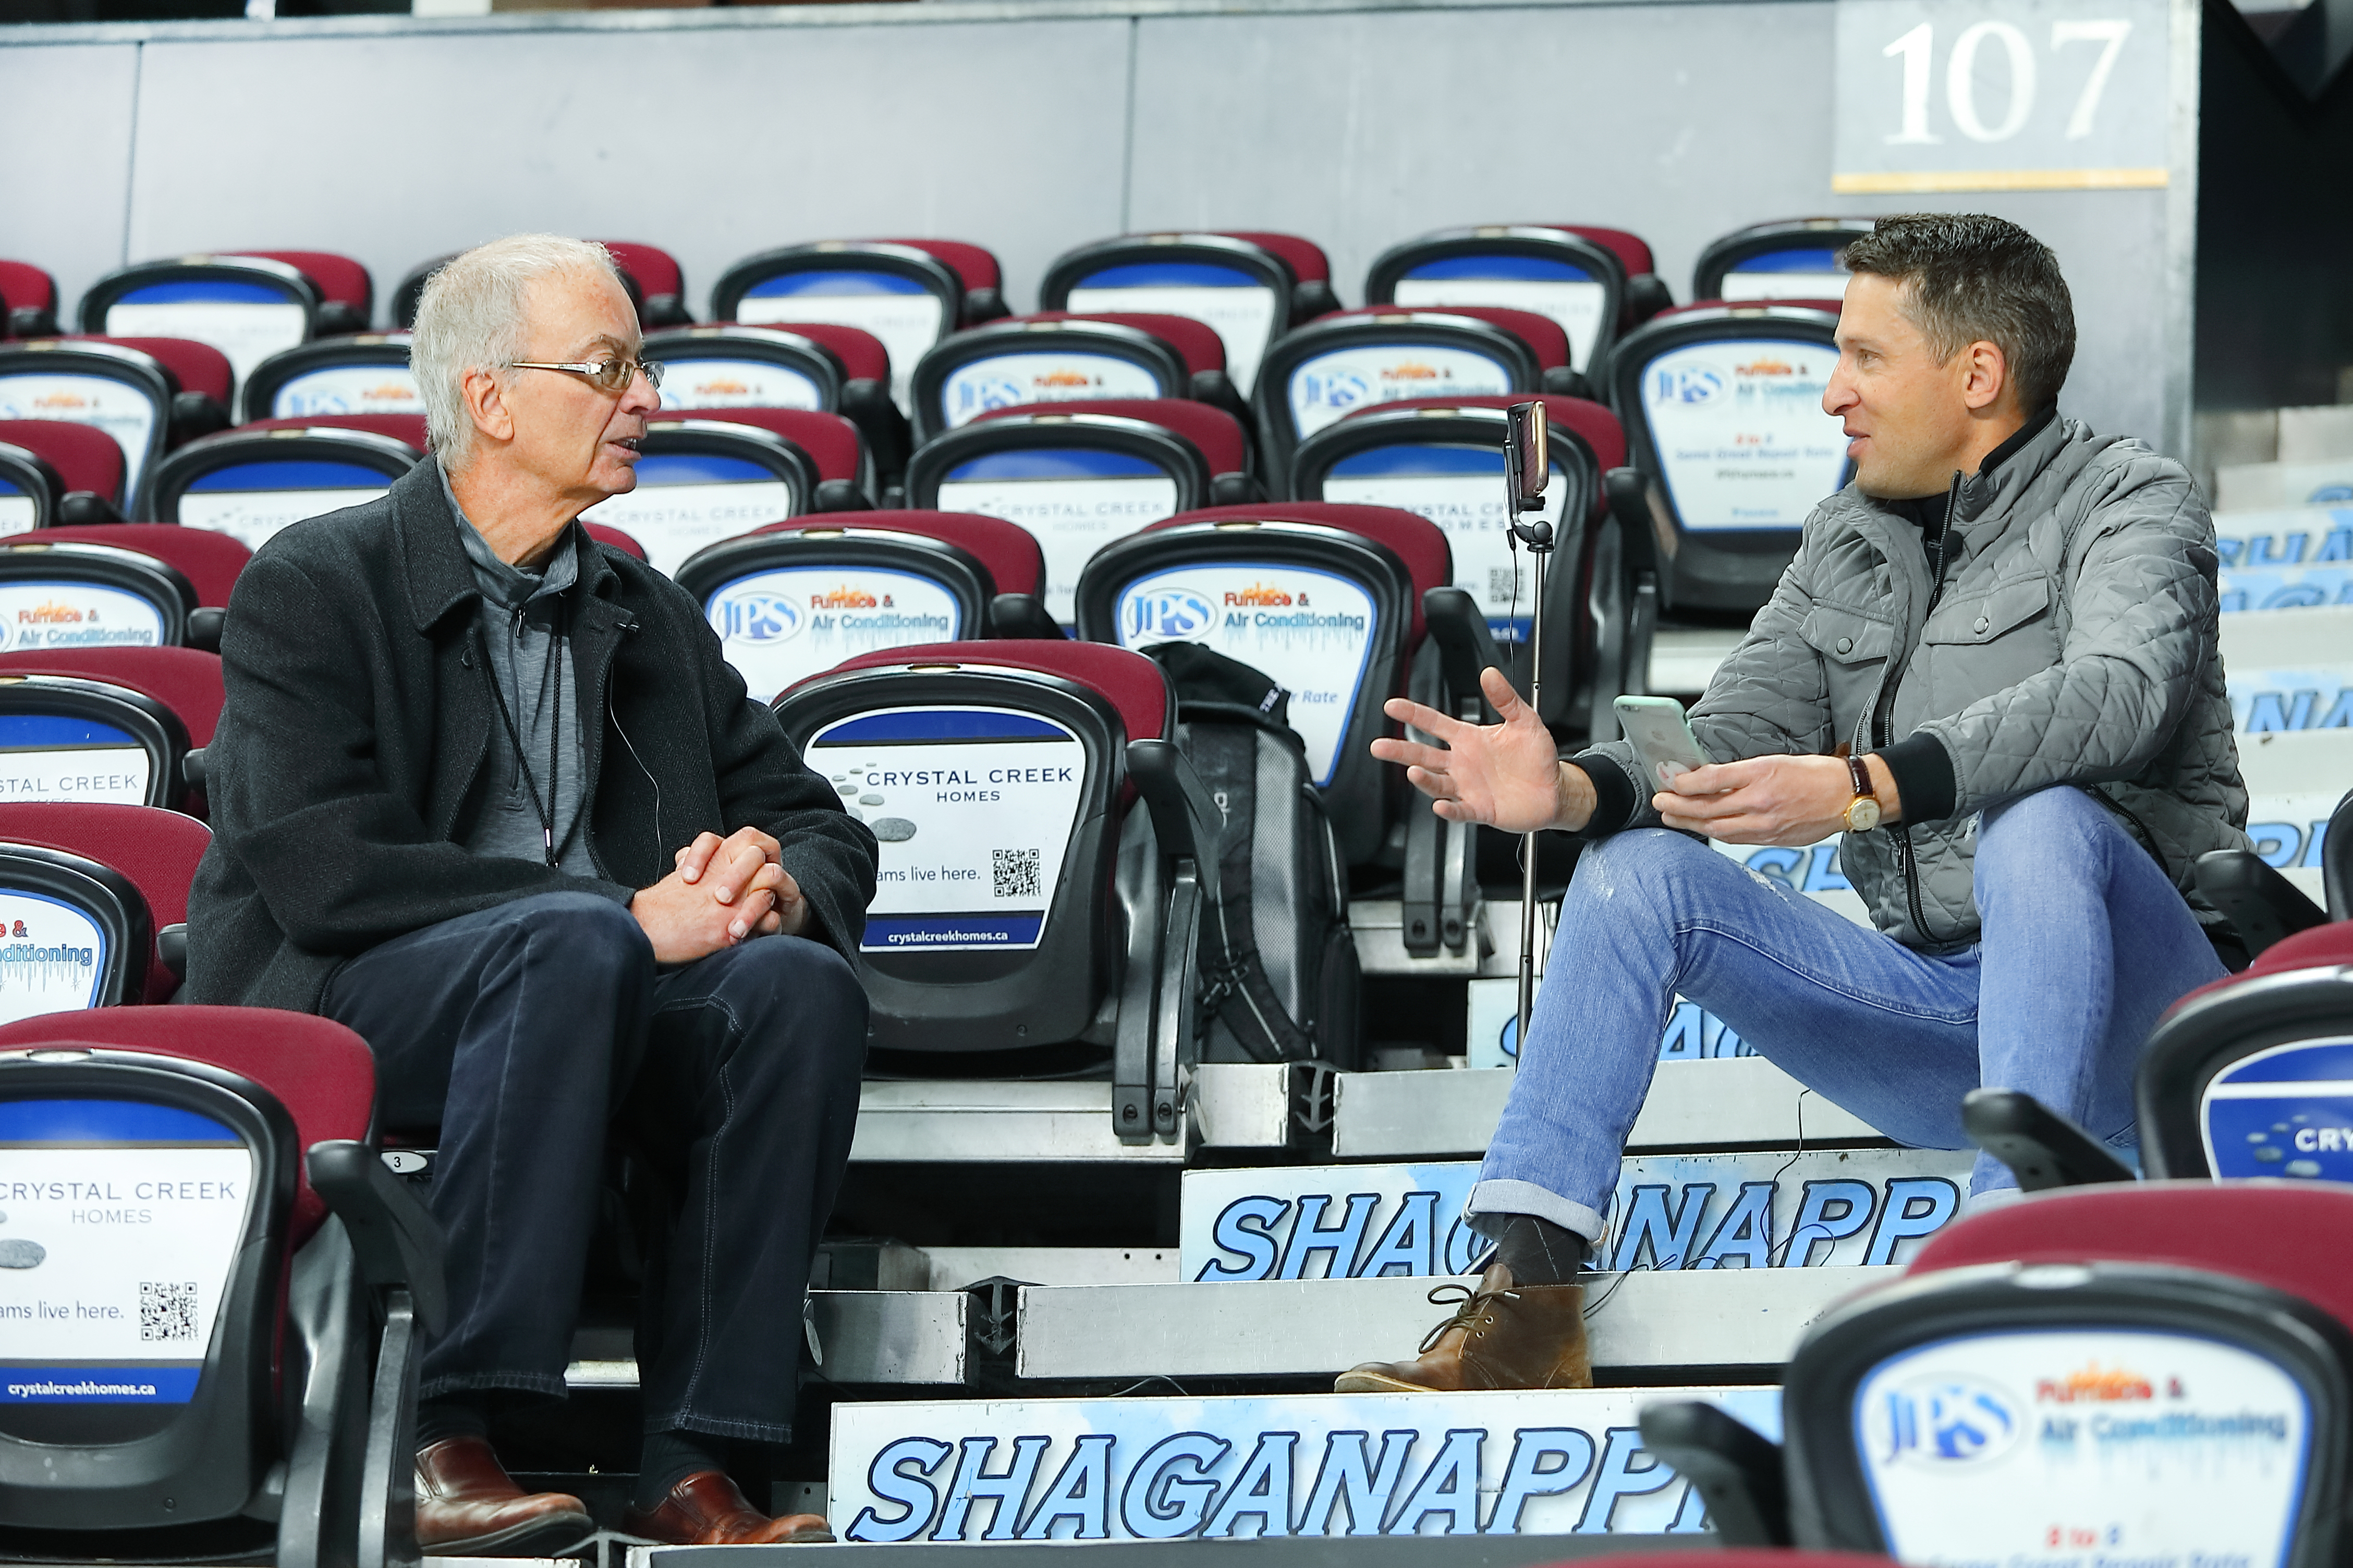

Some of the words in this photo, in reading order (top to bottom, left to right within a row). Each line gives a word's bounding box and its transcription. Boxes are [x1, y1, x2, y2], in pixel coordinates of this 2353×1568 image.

[1881, 19, 2134, 145] 107
[811, 594, 876, 609] Furnace
[883, 595, 894, 608] &
[1225, 592, 1291, 606] Furnace
[1298, 593, 1309, 606] &
[811, 615, 834, 629] Air
[841, 613, 948, 630] Conditioning
[1130, 595, 1209, 639] JPS
[1225, 614, 1249, 627] Air
[1254, 612, 1364, 630] Conditioning
[1303, 691, 1338, 703] Rate
[59, 774, 138, 791] CREEK
[867, 770, 978, 786] CRYSTAL
[989, 767, 1073, 783] CREEK
[936, 790, 1001, 803] HOMES
[911, 865, 936, 881] live
[941, 865, 981, 880] here.
[13, 920, 29, 938] &
[888, 930, 1009, 945] crystalcreekhomes.ca
[394, 1156, 401, 1168] 3
[135, 1182, 236, 1200] CREEK
[72, 1209, 152, 1224] HOMES
[38, 1299, 70, 1319] live
[76, 1299, 125, 1319] here.
[7, 1380, 157, 1399] crystalcreekhomes.ca
